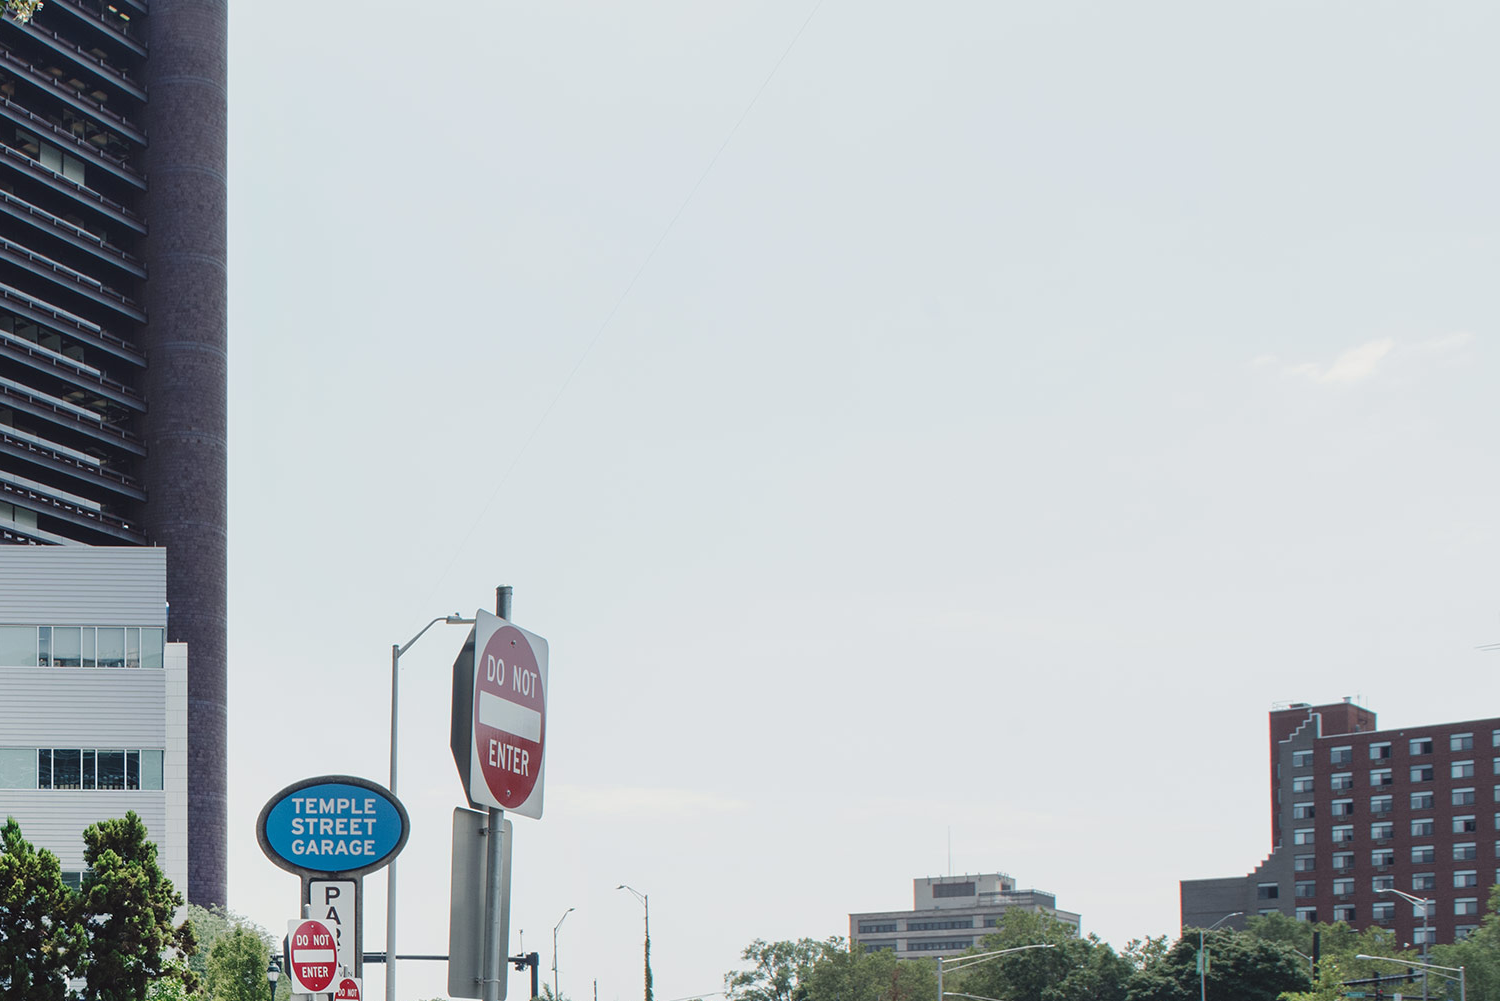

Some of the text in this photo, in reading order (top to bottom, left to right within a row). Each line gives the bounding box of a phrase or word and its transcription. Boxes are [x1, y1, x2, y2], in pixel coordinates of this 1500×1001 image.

[487, 654, 537, 699] DO NOT
[488, 739, 529, 777] ENTER
[291, 797, 376, 814] TEMPLE
[291, 818, 377, 835] STREET
[291, 839, 376, 856] GARAGE
[296, 934, 330, 946] DO NOT
[301, 966, 329, 978] ENTER
[347, 988, 358, 998] NOT
